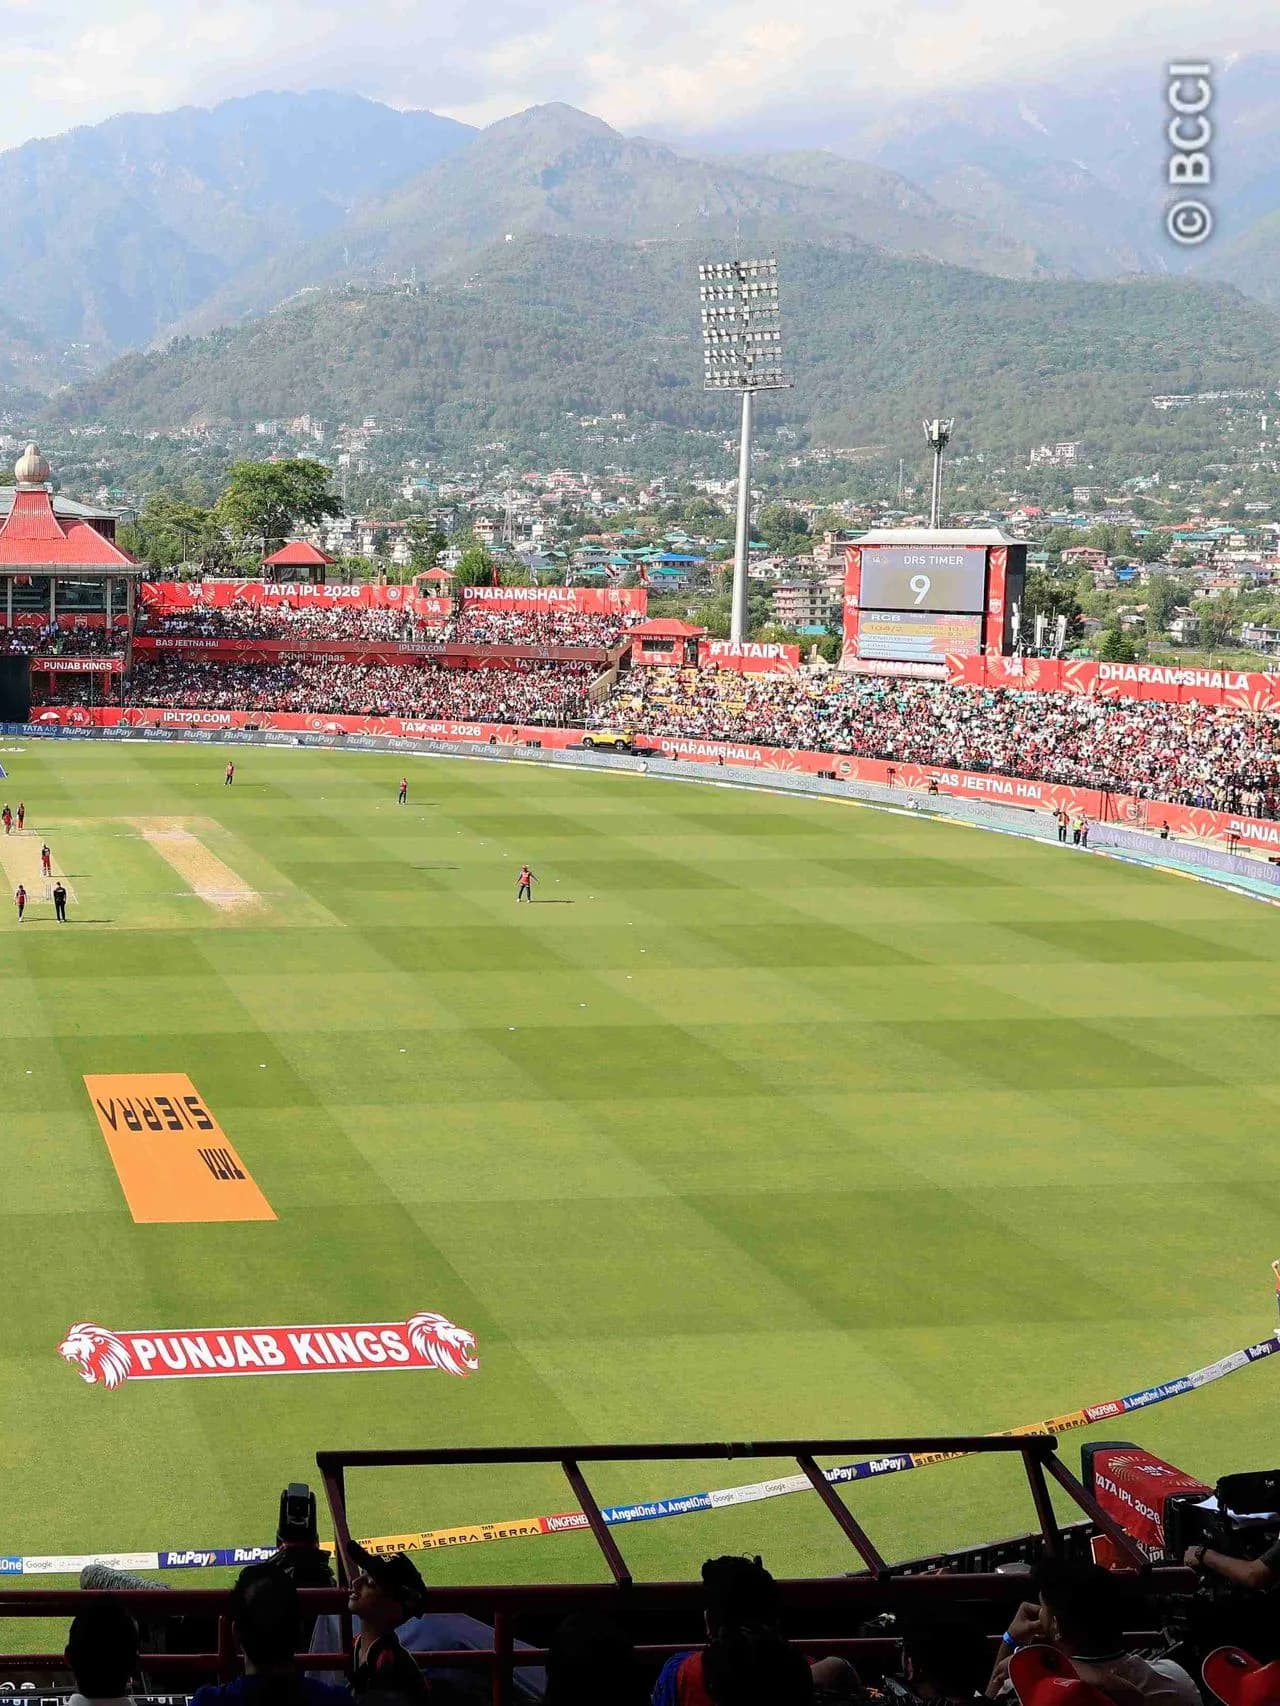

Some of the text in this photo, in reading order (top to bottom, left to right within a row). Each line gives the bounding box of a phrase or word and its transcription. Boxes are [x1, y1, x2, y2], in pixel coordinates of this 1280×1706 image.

[904, 555, 964, 565] DRS TIMER
[263, 584, 361, 597] TATA IPL 2026
[464, 587, 577, 600] DHARAMSHALA
[909, 574, 931, 605] 9
[155, 639, 173, 647] BAS
[175, 639, 204, 647] JEETNA
[399, 644, 447, 652] IPLT20.COM
[710, 643, 789, 659] #TATAIPL
[44, 661, 113, 671] PUNJAB KINGS
[563, 661, 592, 670] 2026
[1098, 664, 1249, 691] DHARAMSHALA
[163, 712, 231, 723] IPLT20.COM
[62, 728, 92, 738] RuPay
[103, 728, 133, 738] RuPay
[143, 729, 173, 738] RuPay
[183, 730, 213, 740] RuPay
[224, 731, 254, 741] RuPay
[431, 724, 448, 734] IPL
[450, 725, 482, 737] 2026
[305, 734, 335, 744] RuPay
[346, 736, 377, 746] RuPay
[387, 738, 420, 748] RuPay
[429, 741, 460, 751] RuPay
[471, 744, 502, 755] RuPay
[513, 747, 545, 758] RuPay
[661, 740, 762, 761] DHARAMSHALA
[962, 775, 1013, 794] JEETNA
[1016, 785, 1042, 799] HAI
[1106, 833, 1154, 851] AngelOne
[1169, 846, 1219, 865] AngelOne
[96, 1096, 214, 1132] SIERRA
[196, 1148, 247, 1181] TATA
[130, 1329, 411, 1372] PUNJAB KINGS
[1248, 1343, 1271, 1359] RuPay
[1047, 1418, 1087, 1434] SIERRA
[870, 1457, 903, 1473] RuPay
[764, 1482, 786, 1494] Google
[668, 1495, 711, 1512] AngelOne
[712, 1492, 734, 1503] Google
[1094, 1472, 1161, 1525] TATA IPL 2026
[611, 1505, 657, 1521] AngelOne
[546, 1514, 589, 1531] KINGFISHE
[483, 1526, 539, 1540] SIERRA
[422, 1534, 479, 1548] SIERRA
[26, 1559, 53, 1570] Google
[93, 1558, 121, 1568] Google
[167, 1551, 210, 1567] RuPay
